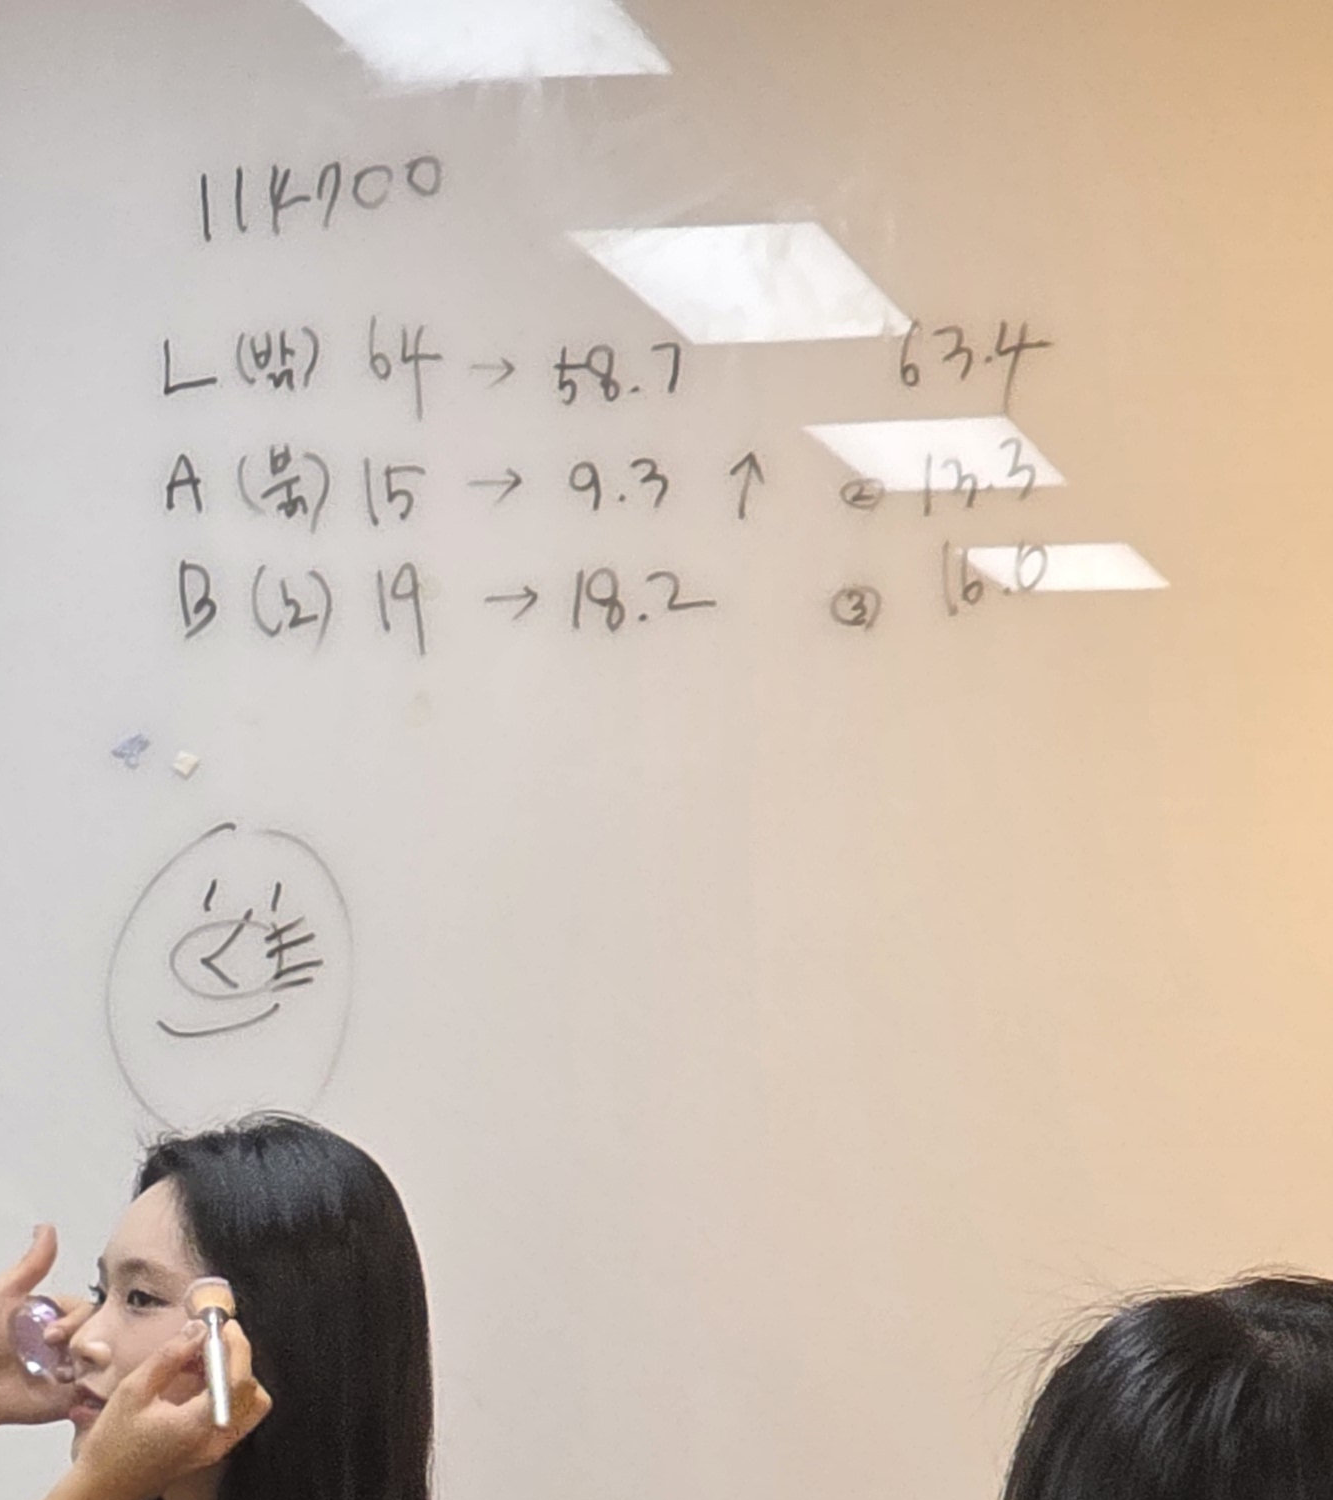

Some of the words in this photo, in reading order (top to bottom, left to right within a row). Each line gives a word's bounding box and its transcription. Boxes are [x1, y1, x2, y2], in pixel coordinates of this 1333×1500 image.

[161, 338, 218, 396] L
[368, 315, 443, 421] 64
[553, 341, 682, 405] 58.7
[900, 318, 1053, 416] 63.4
[165, 453, 203, 513] A
[362, 457, 427, 526] 15
[568, 458, 670, 511] 9.3
[922, 437, 1036, 517] 13.3
[178, 559, 218, 640] B
[375, 561, 427, 656] 19
[571, 564, 718, 633] 18.2
[943, 538, 1048, 617] 16.0
